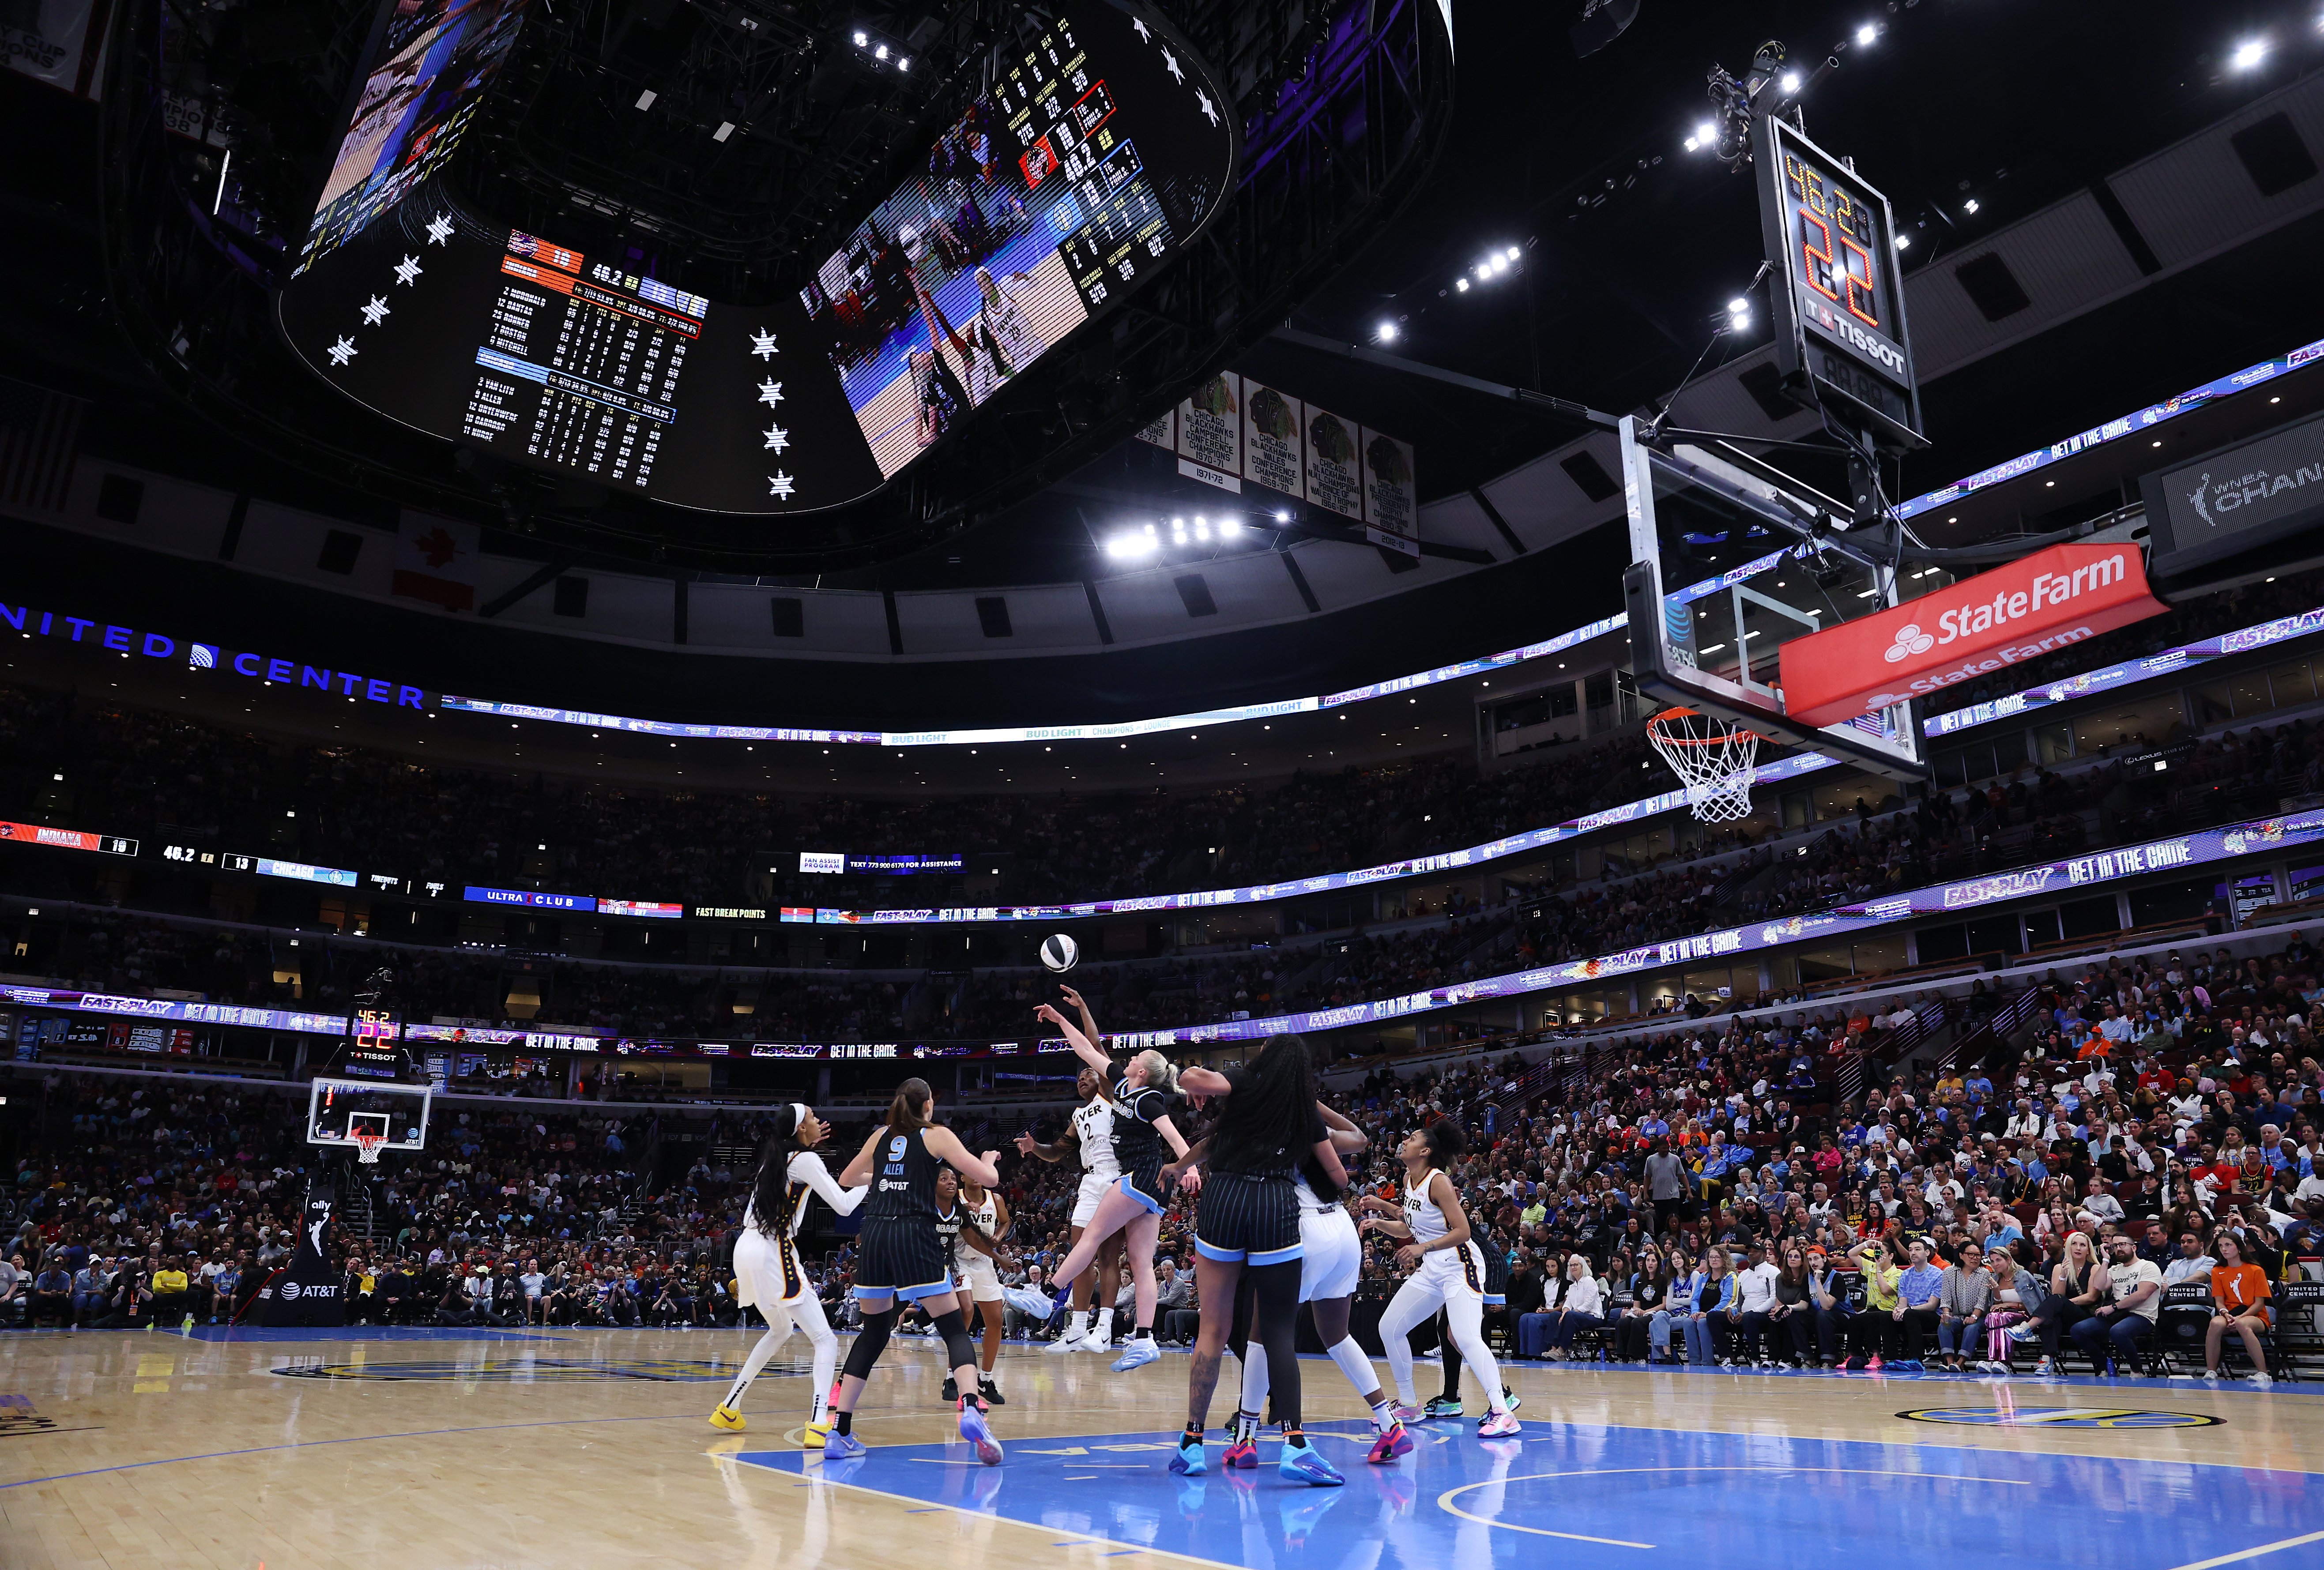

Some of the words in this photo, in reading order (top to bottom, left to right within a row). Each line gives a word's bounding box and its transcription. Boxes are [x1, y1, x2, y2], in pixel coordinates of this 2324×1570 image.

[1785, 154, 1854, 235] 46.2
[1799, 208, 1878, 326] 22
[1834, 317, 1904, 375] TISSOT
[1186, 414, 1233, 438] BLACKHAWKS
[1194, 410, 1224, 427] CHICAGO
[1186, 431, 1233, 454] CONFERENCE
[1190, 424, 1228, 445] CAMPBELL
[1259, 433, 1287, 451] CHICAGO
[2050, 441, 2070, 459] GET
[2071, 437, 2080, 452] IN
[2081, 428, 2101, 448] THE
[2102, 416, 2132, 440] GAME
[1189, 441, 1230, 462] CHAMPIONS
[1251, 438, 1296, 462] BLACKHAWKS
[1263, 451, 1285, 466] WALES
[1196, 451, 1224, 468] 1970-71
[1252, 456, 1297, 478] CONFERENCE
[1320, 459, 1346, 475] CHICAGO
[1197, 468, 1223, 485] 1971-72
[1255, 465, 1294, 486] CHAMPIONS
[1313, 463, 1355, 486] BLACKHAWKS
[1260, 475, 1289, 492] 1969-70
[1319, 482, 1340, 496] PRINCE
[1324, 476, 1360, 494] CHAMPIONS
[2215, 463, 2324, 512] CHAN
[1311, 486, 1331, 499] WALES
[1333, 495, 1358, 509] TROPHY
[1322, 501, 1348, 514] 1966-67
[1382, 535, 1404, 549] 2012-13
[1938, 591, 2028, 645] State
[2031, 554, 2125, 612] Farm
[1910, 659, 2002, 693] State
[1997, 626, 2094, 663] Farm
[234, 653, 424, 710] CENTER
[1379, 681, 1391, 694] GET
[1392, 679, 1398, 691] IN
[1399, 677, 1412, 689] THE
[1412, 672, 1431, 685] GAME
[1271, 701, 1302, 713] LIGHT
[1092, 723, 1134, 735] CHAMPIONS
[1144, 720, 1171, 730] LOUNGE
[2135, 752, 2162, 761] LEXUS
[37, 828, 81, 846] INDIANA
[113, 840, 127, 852] 19
[164, 846, 195, 861] 46.2
[236, 858, 249, 870] 13
[272, 862, 315, 878] CHICAGO
[1412, 858, 1426, 873] GET
[1427, 857, 1434, 870] IN
[1435, 855, 1449, 869] THE
[1451, 851, 1471, 866] GAME
[2068, 861, 2094, 884] GET
[2095, 856, 2114, 879] IN
[2116, 849, 2145, 876] THE
[2146, 839, 2193, 869] GAME
[487, 892, 522, 902] ULTRA
[535, 896, 573, 906] CLUB
[696, 907, 713, 917] FAST
[715, 908, 738, 917] BREAK
[739, 909, 765, 919] POINTS
[939, 909, 952, 920] GET
[954, 909, 961, 920] IN
[963, 909, 976, 919] THE
[977, 908, 998, 919] GAME
[1659, 945, 1679, 964] GET
[1680, 941, 1691, 959] IN
[1691, 936, 1711, 957] THE
[1712, 930, 1742, 954] GAME
[358, 1010, 389, 1024] 46.2
[357, 1023, 395, 1049] 22
[363, 1052, 396, 1061] TISSOT
[830, 1045, 846, 1058] GET
[847, 1045, 856, 1058] IN
[858, 1045, 872, 1058] THE
[874, 1045, 897, 1057] GAME
[1074, 1104, 1103, 1127] EVER
[1084, 1123, 1094, 1141] 2
[888, 1135, 907, 1161] 9
[883, 1163, 904, 1175] ALLEN
[888, 1182, 909, 1190] AT&T
[2249, 1182, 2259, 1190] 22
[312, 1200, 331, 1211] ally
[971, 1214, 992, 1223] VER
[302, 1286, 338, 1297] AT&T
